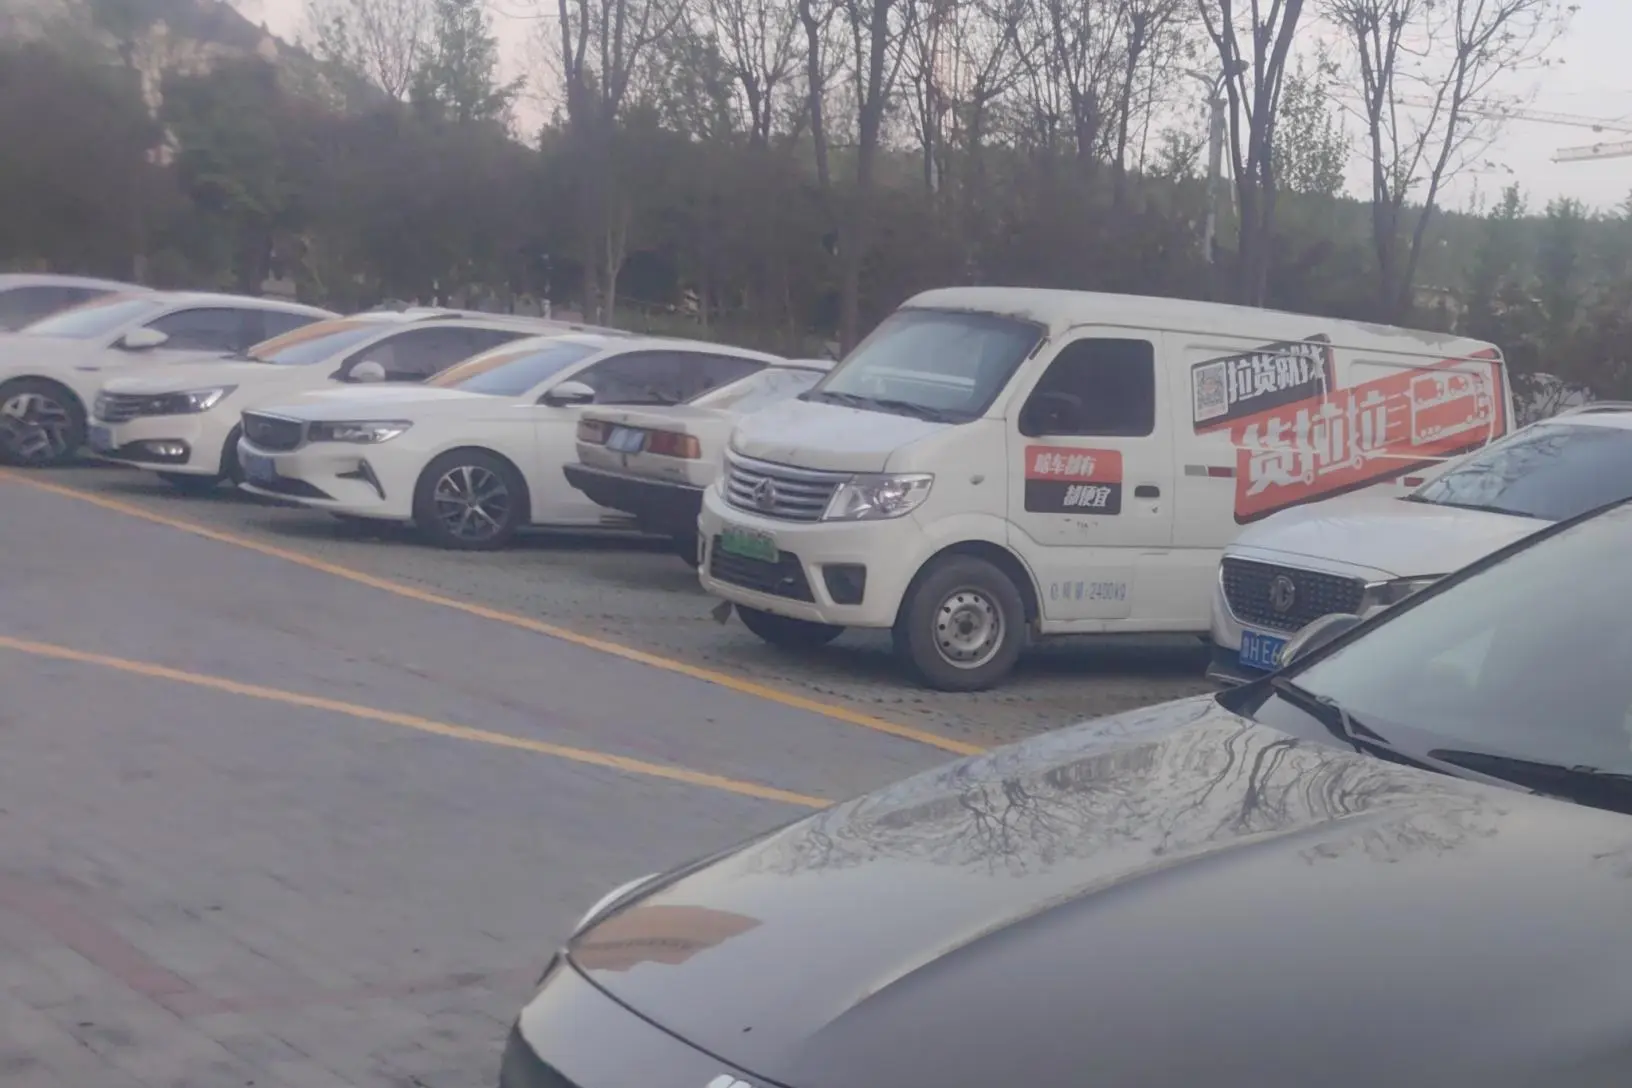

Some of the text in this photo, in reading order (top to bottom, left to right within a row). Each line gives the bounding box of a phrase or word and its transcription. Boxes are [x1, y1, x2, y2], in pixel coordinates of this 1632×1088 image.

[1228, 346, 1326, 404] 拉货就找
[1243, 390, 1388, 497] 货拉拉
